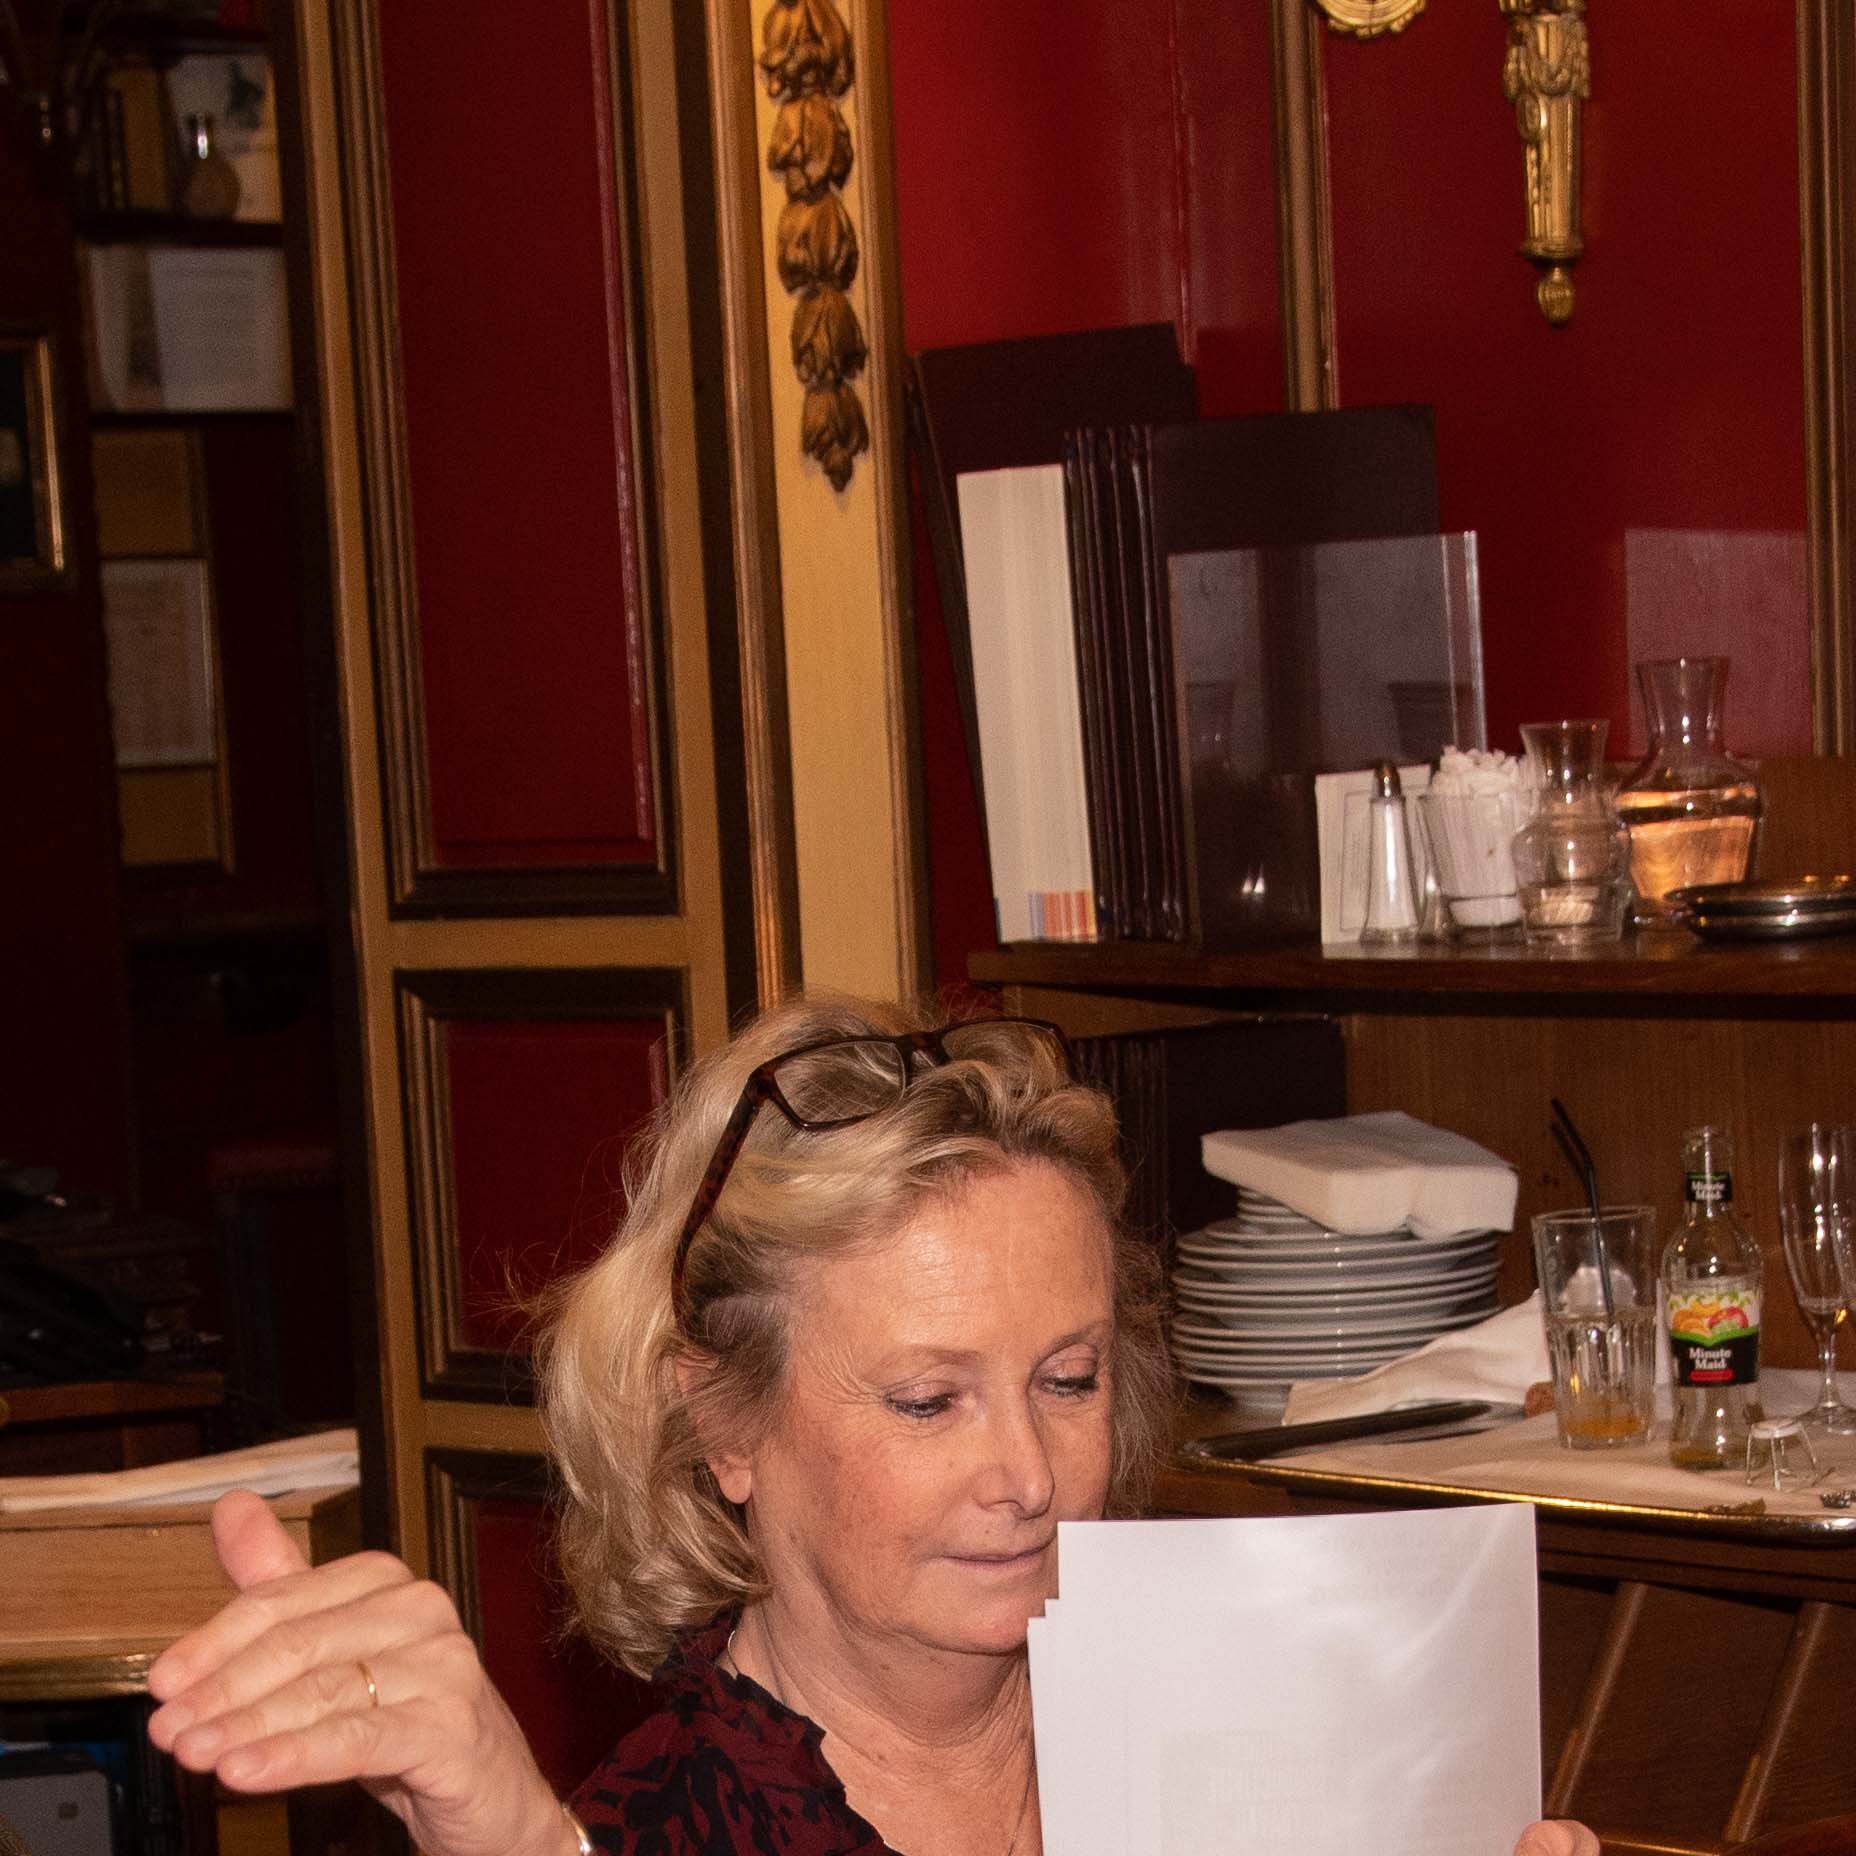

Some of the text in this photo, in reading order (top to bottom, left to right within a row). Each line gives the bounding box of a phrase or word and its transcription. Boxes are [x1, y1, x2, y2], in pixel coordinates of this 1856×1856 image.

[1691, 1181, 1725, 1190] Minute
[1690, 1347, 1732, 1358] Minute
[1695, 1358, 1727, 1369] Maid
